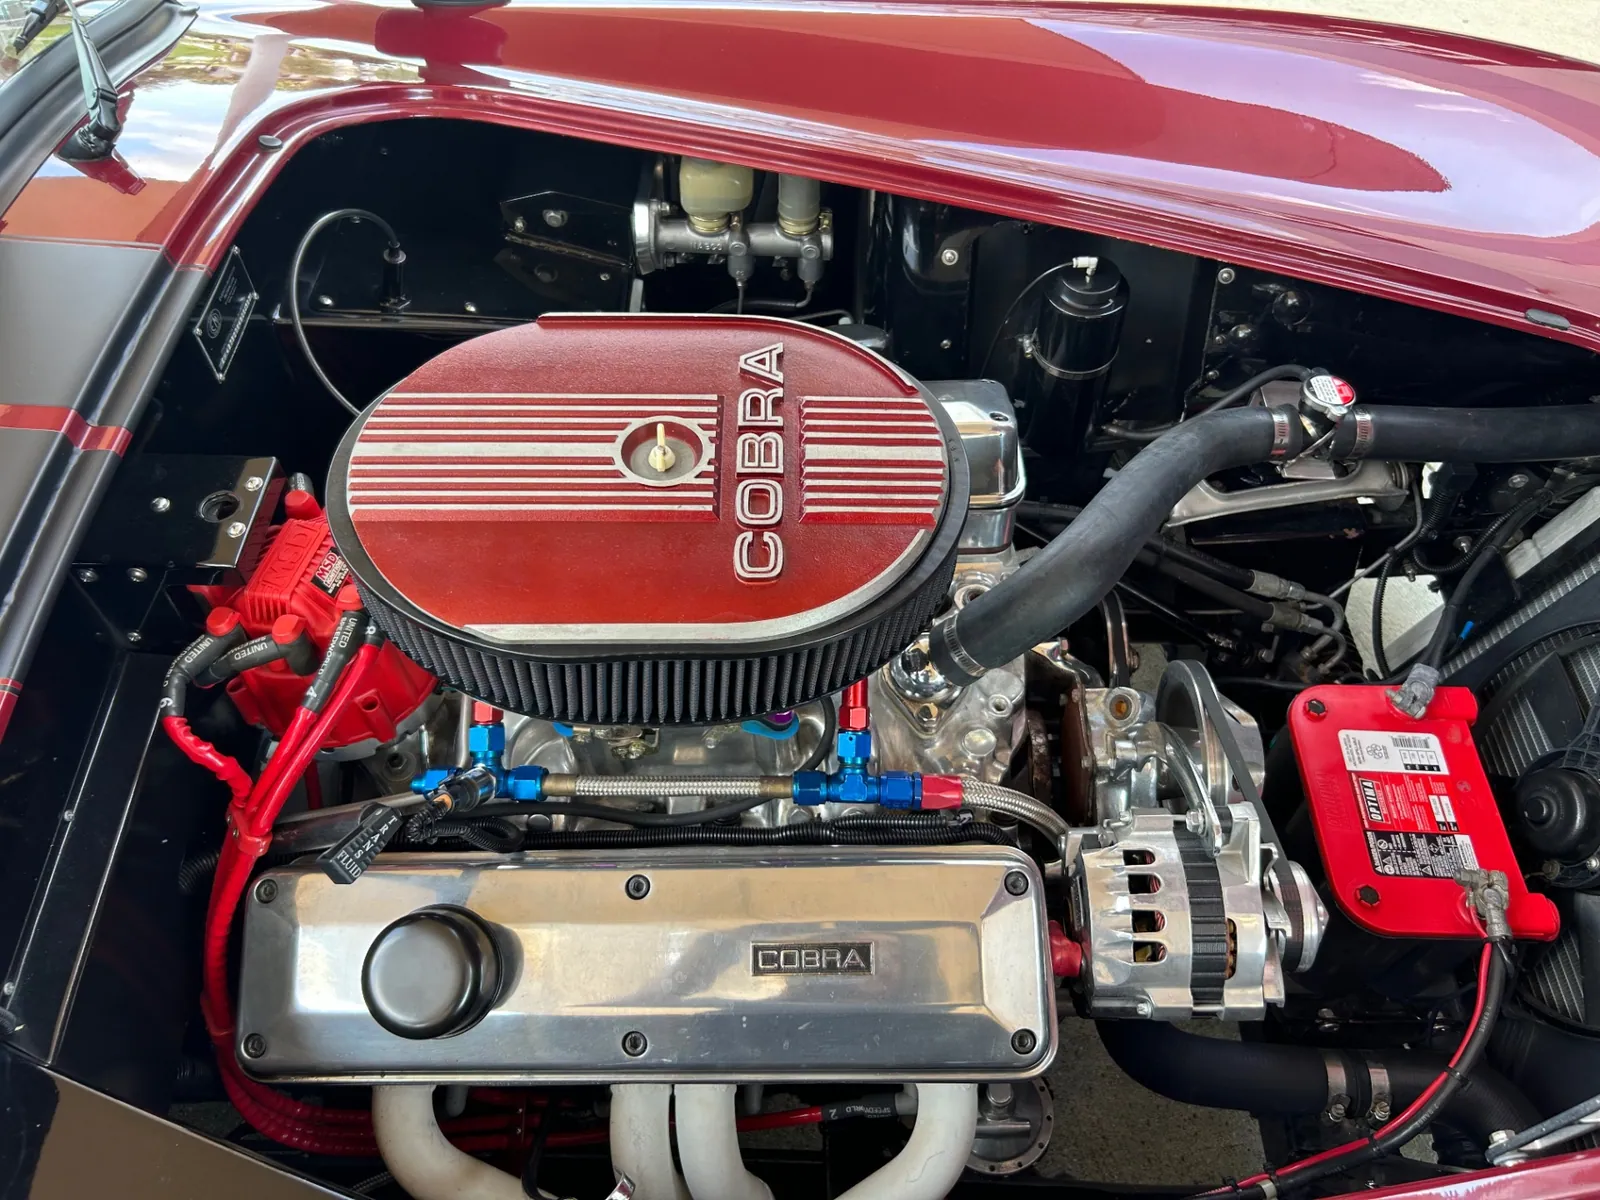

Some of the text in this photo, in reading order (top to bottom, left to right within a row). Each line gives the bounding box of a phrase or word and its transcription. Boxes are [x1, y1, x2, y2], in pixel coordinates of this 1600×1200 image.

[734, 342, 784, 579] COBRA
[265, 528, 312, 585] MSD
[315, 551, 338, 581] MSD
[318, 617, 347, 675] SPEEDWORLD
[339, 617, 358, 648] UNITED
[184, 637, 214, 664] UNITED
[234, 642, 268, 661] UNITED
[1361, 781, 1382, 821] OPTIMA
[355, 816, 397, 859] TRANS
[337, 850, 363, 878] FLUID
[758, 949, 865, 968] COBRA
[829, 1108, 839, 1120] 2
[845, 1104, 891, 1114] SPEEDWORLD
